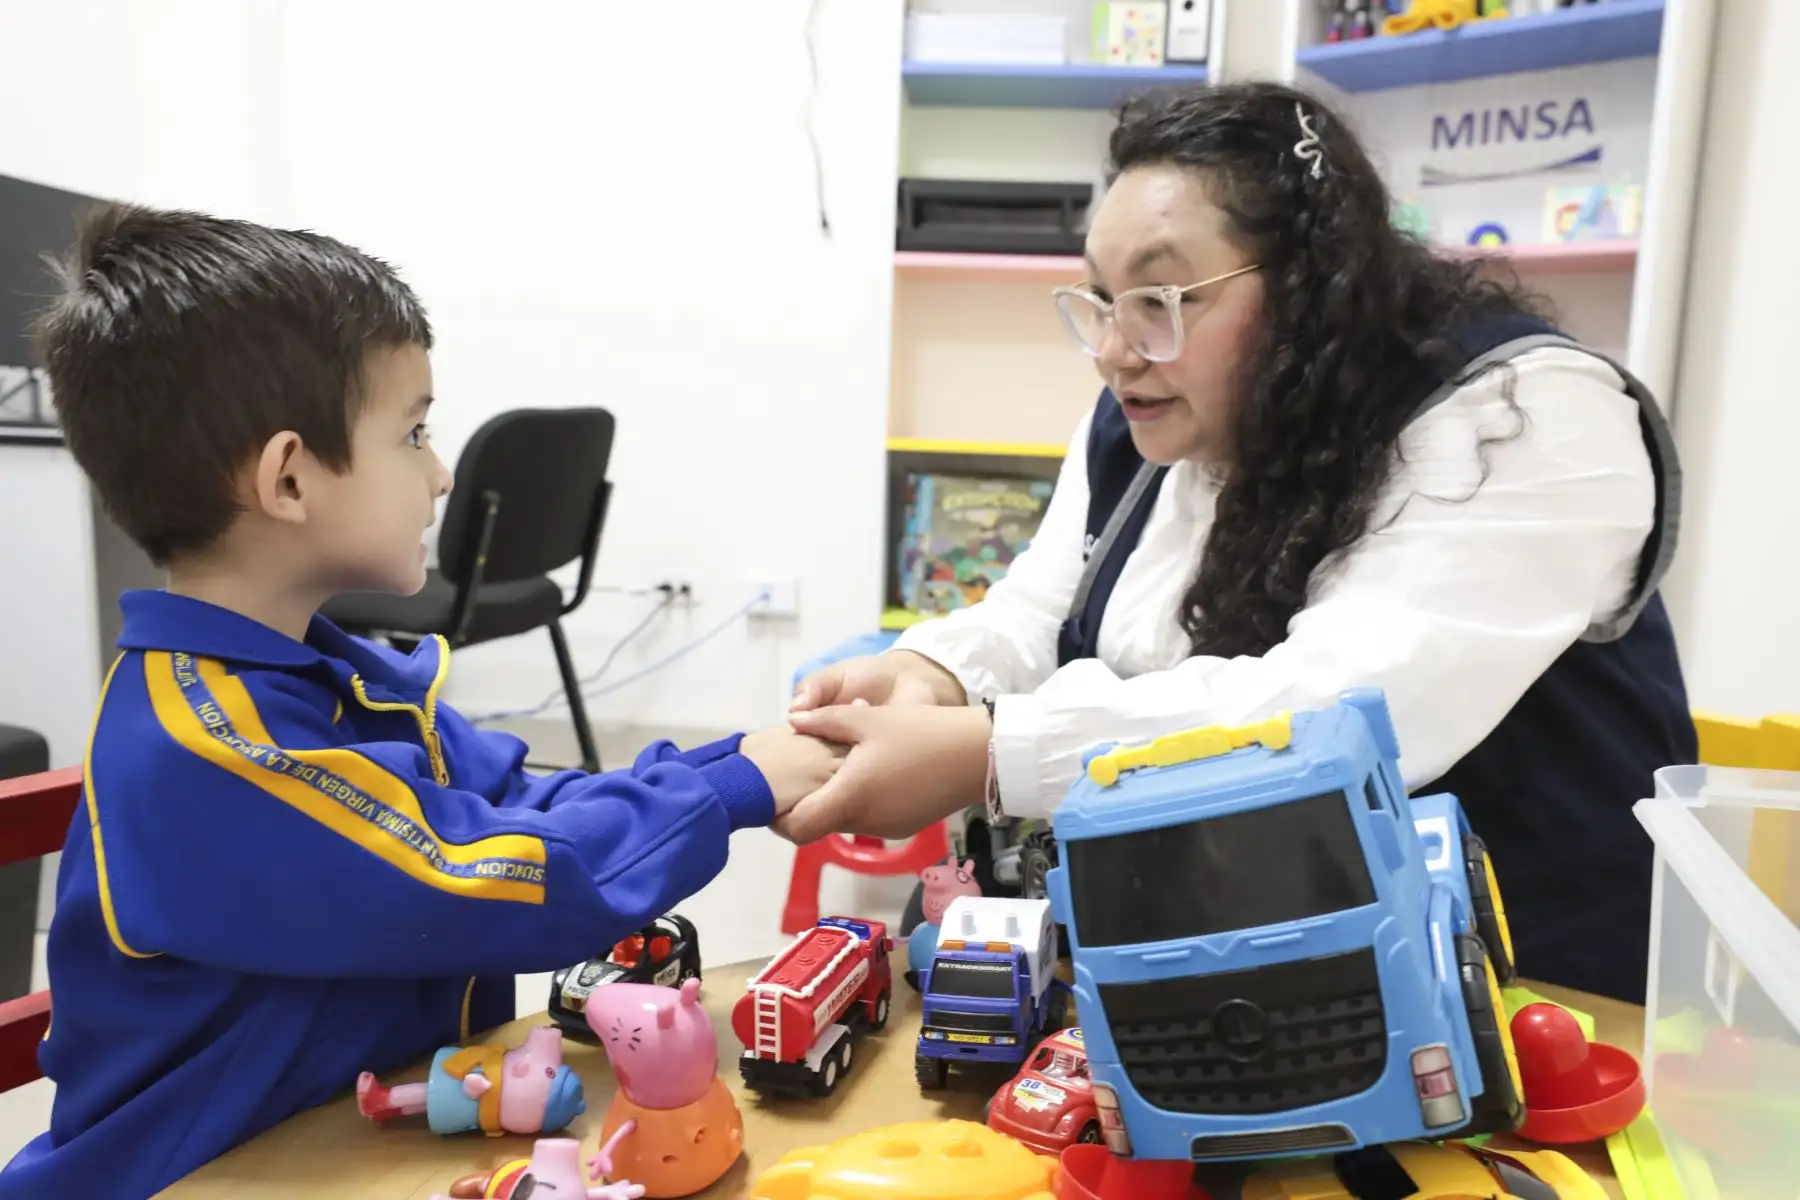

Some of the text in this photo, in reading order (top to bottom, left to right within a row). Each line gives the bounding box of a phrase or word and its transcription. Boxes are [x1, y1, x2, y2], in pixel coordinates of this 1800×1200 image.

[1433, 98, 1594, 149] MINSA
[266, 752, 292, 772] LA
[294, 765, 317, 781] DE
[318, 775, 374, 818] VIRGEN
[1021, 1079, 1041, 1090] 38
